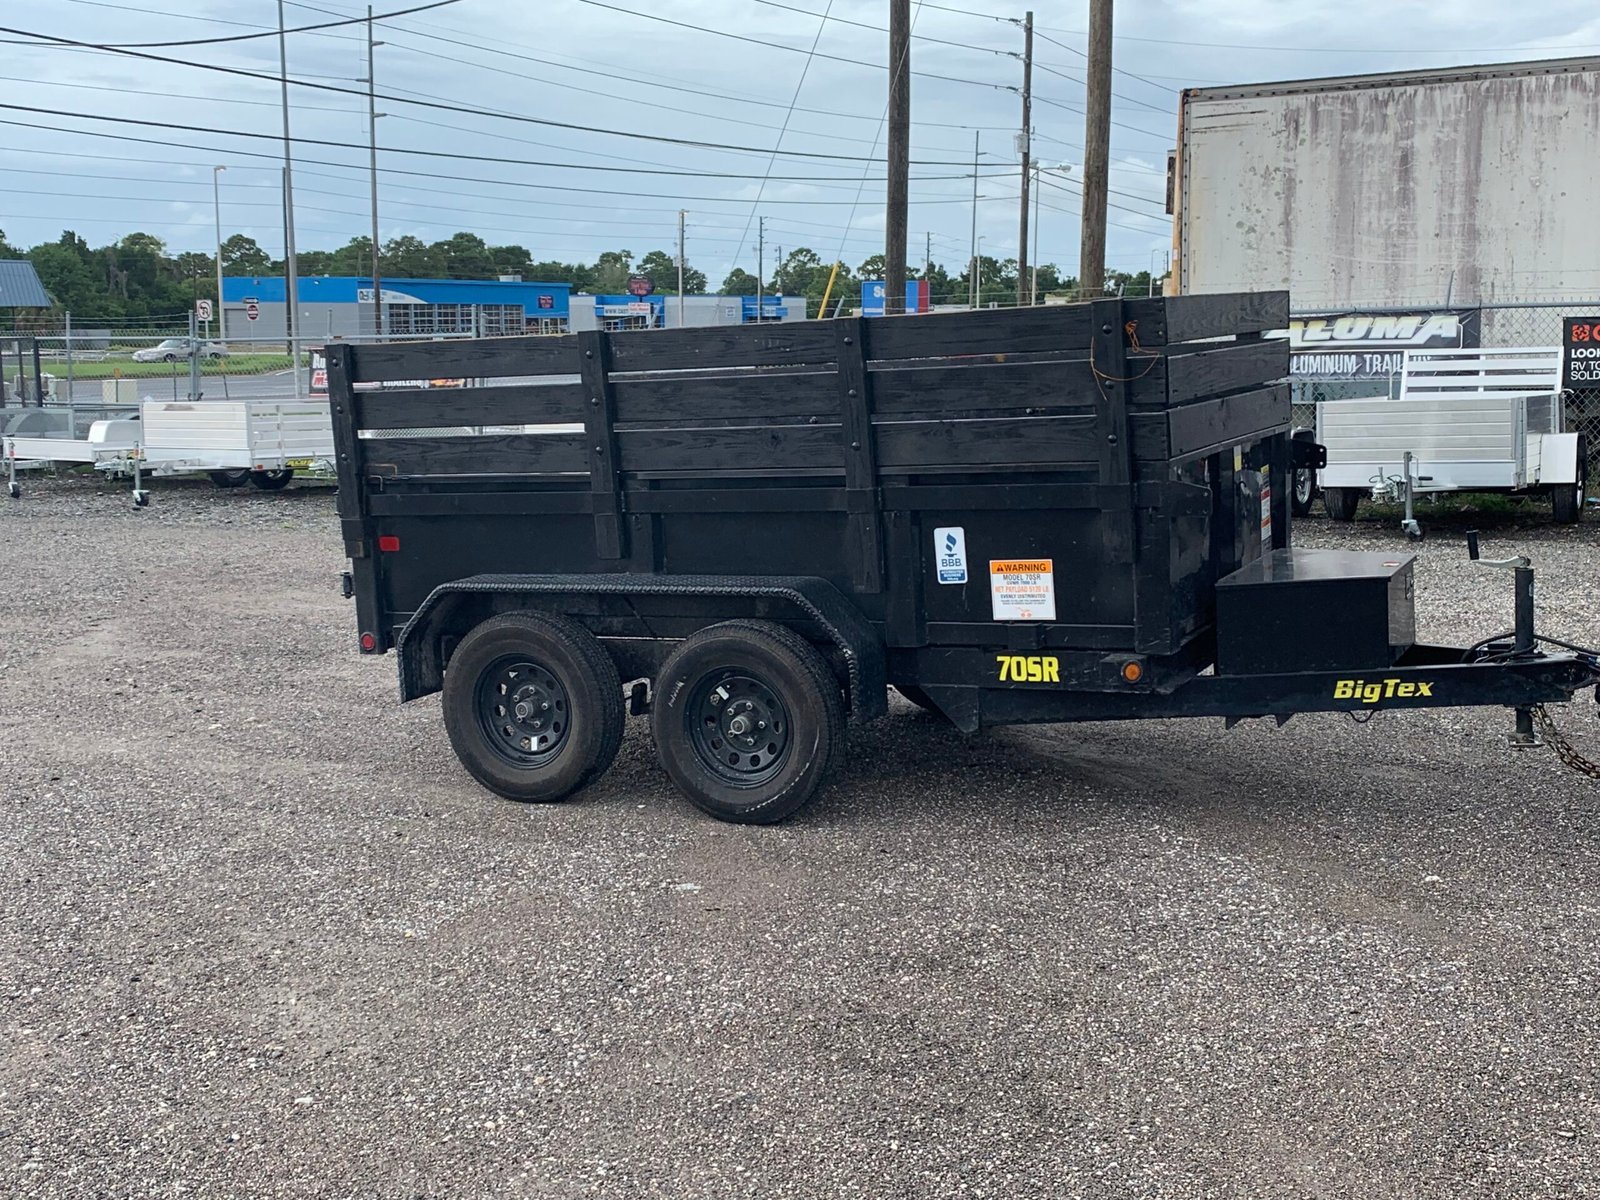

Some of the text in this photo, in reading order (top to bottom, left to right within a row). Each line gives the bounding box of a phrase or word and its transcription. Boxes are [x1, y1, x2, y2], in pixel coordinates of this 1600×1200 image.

[1290, 355, 1357, 375] LUMINUM
[1571, 361, 1586, 370] RV
[1570, 370, 1600, 380] SOLD
[941, 558, 962, 567] BBB
[1004, 563, 1047, 572] WARNING
[1026, 573, 1041, 581] 70SR
[997, 655, 1060, 683] 70SR
[1333, 678, 1435, 703] BigTex
